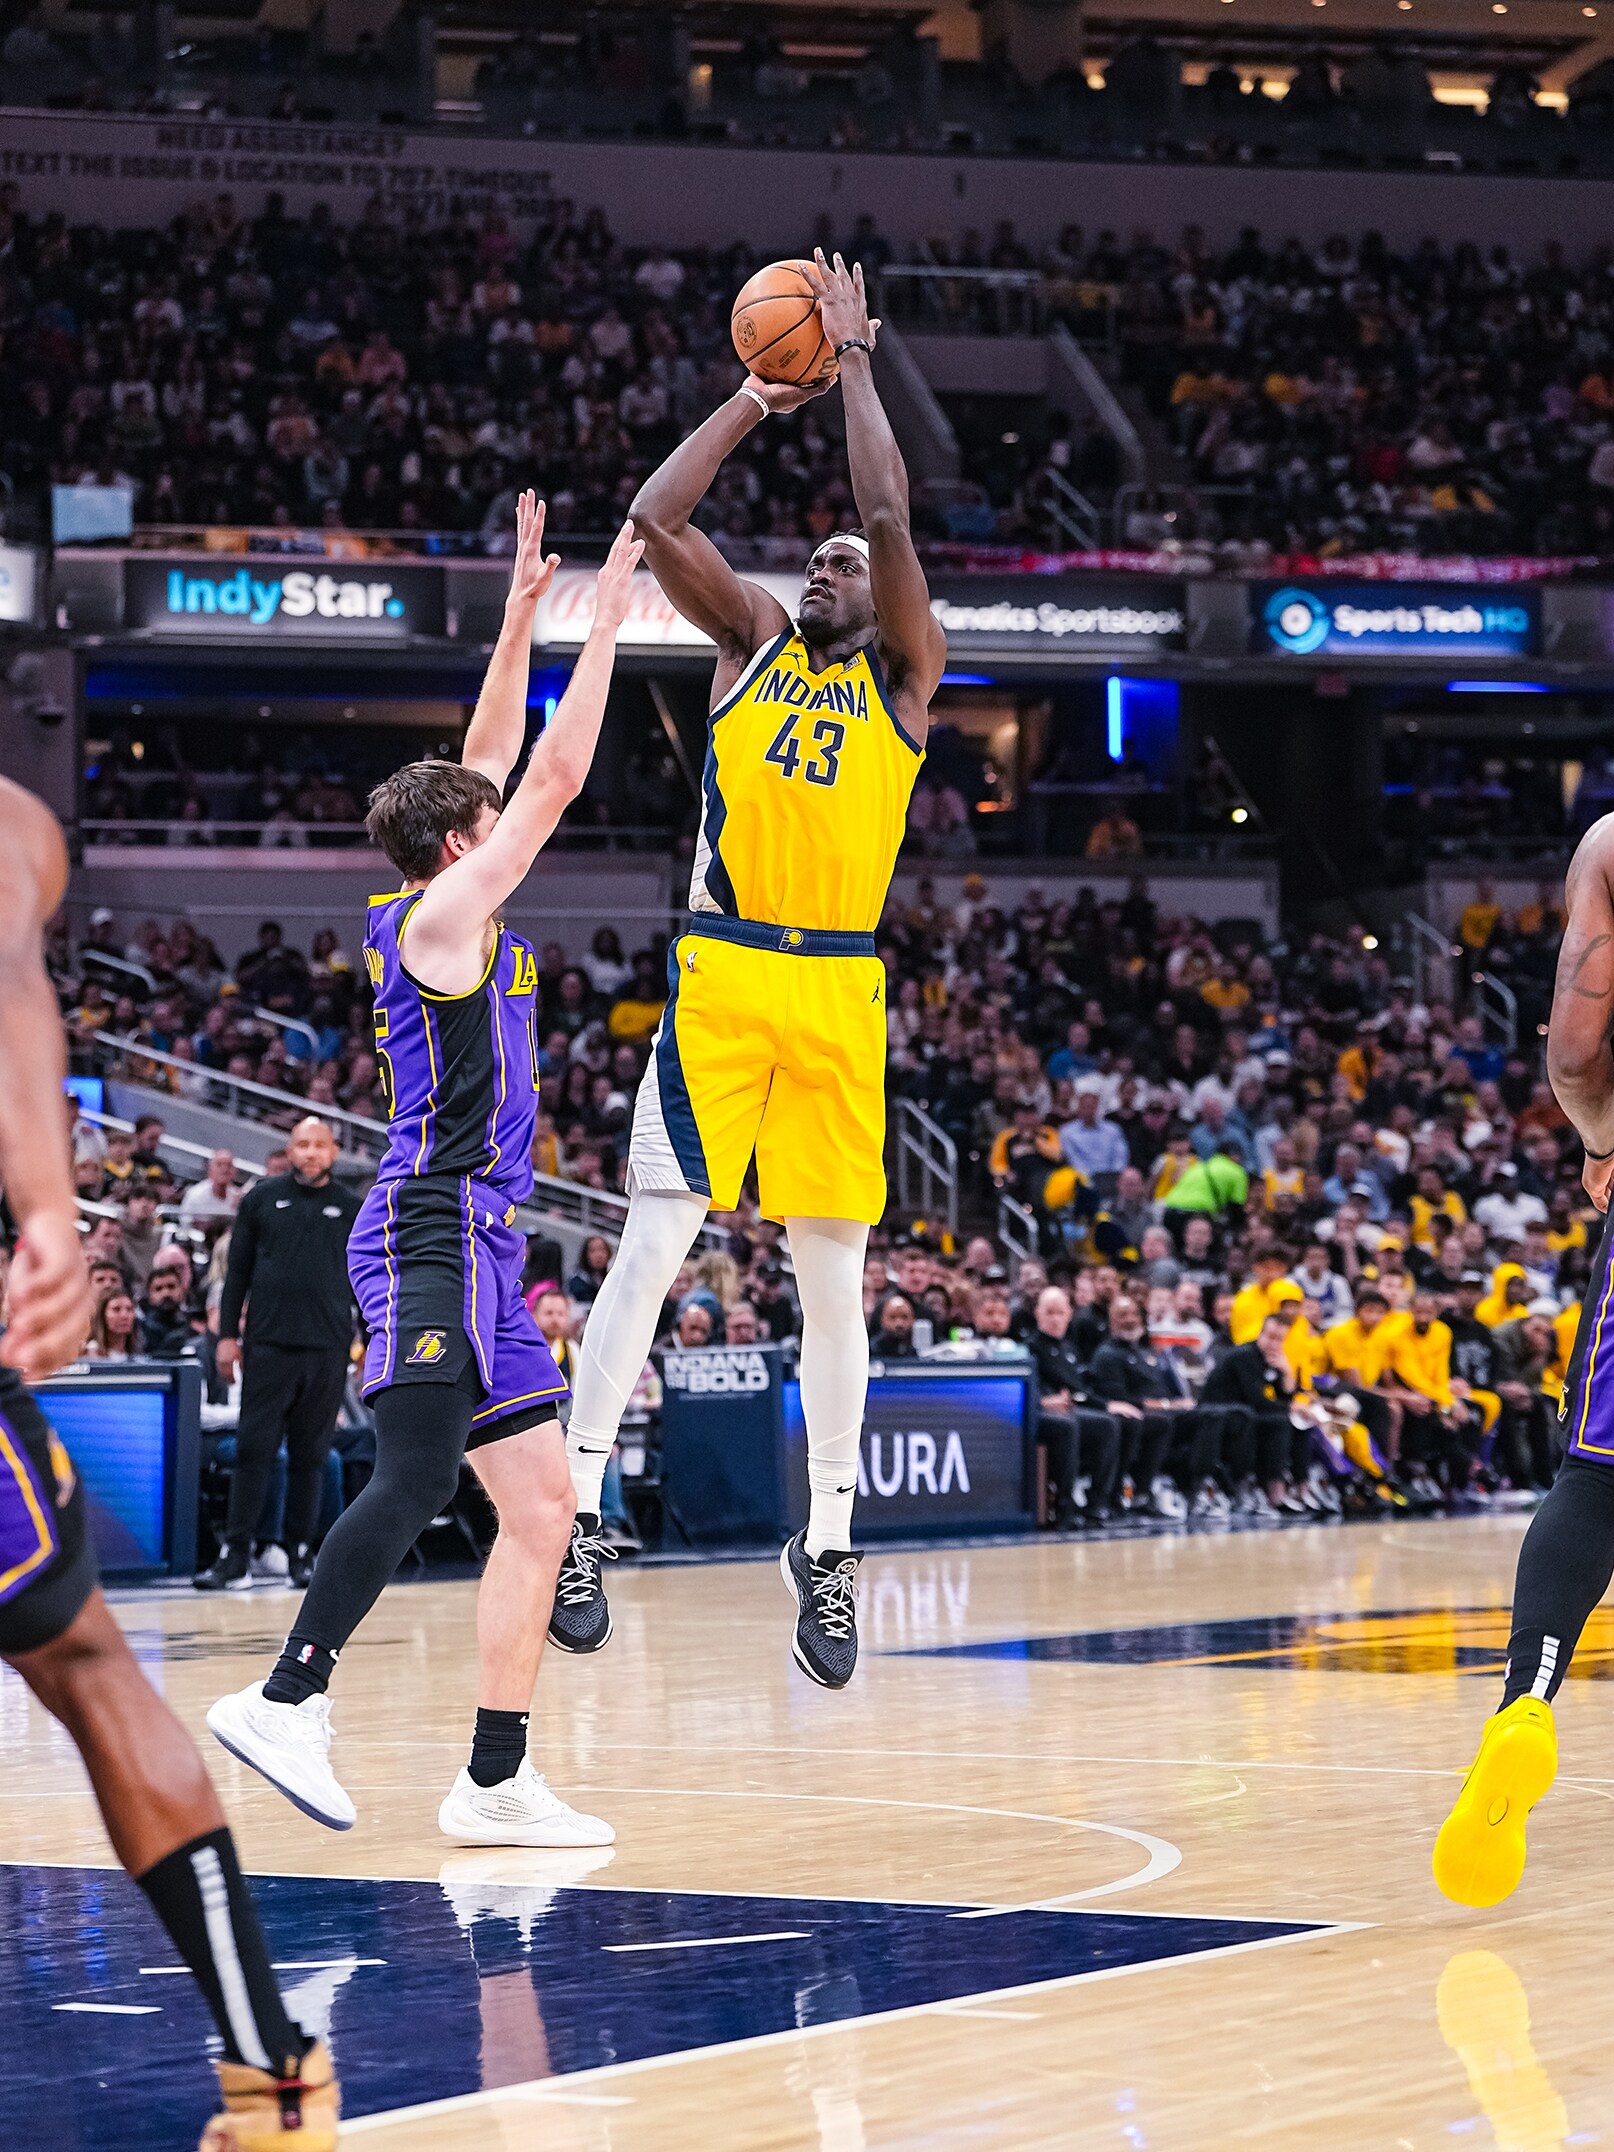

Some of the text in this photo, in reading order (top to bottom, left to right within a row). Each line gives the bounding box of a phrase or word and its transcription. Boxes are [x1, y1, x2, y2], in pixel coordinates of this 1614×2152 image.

[156, 127, 405, 157] NEED ASSISTANCE?
[2, 150, 60, 175] TEXT
[69, 152, 113, 177] THE
[120, 155, 195, 179] ISSUE
[223, 158, 344, 184] LOCATION
[167, 568, 405, 624] IndyStar.
[1037, 601, 1184, 637] Sportsbook
[1332, 604, 1423, 637] Sports
[1420, 604, 1484, 633] Tech
[753, 668, 869, 722] INDIANA
[764, 713, 846, 787] 43
[664, 1352, 768, 1373] INDIANA
[688, 1371, 770, 1393] BOLD
